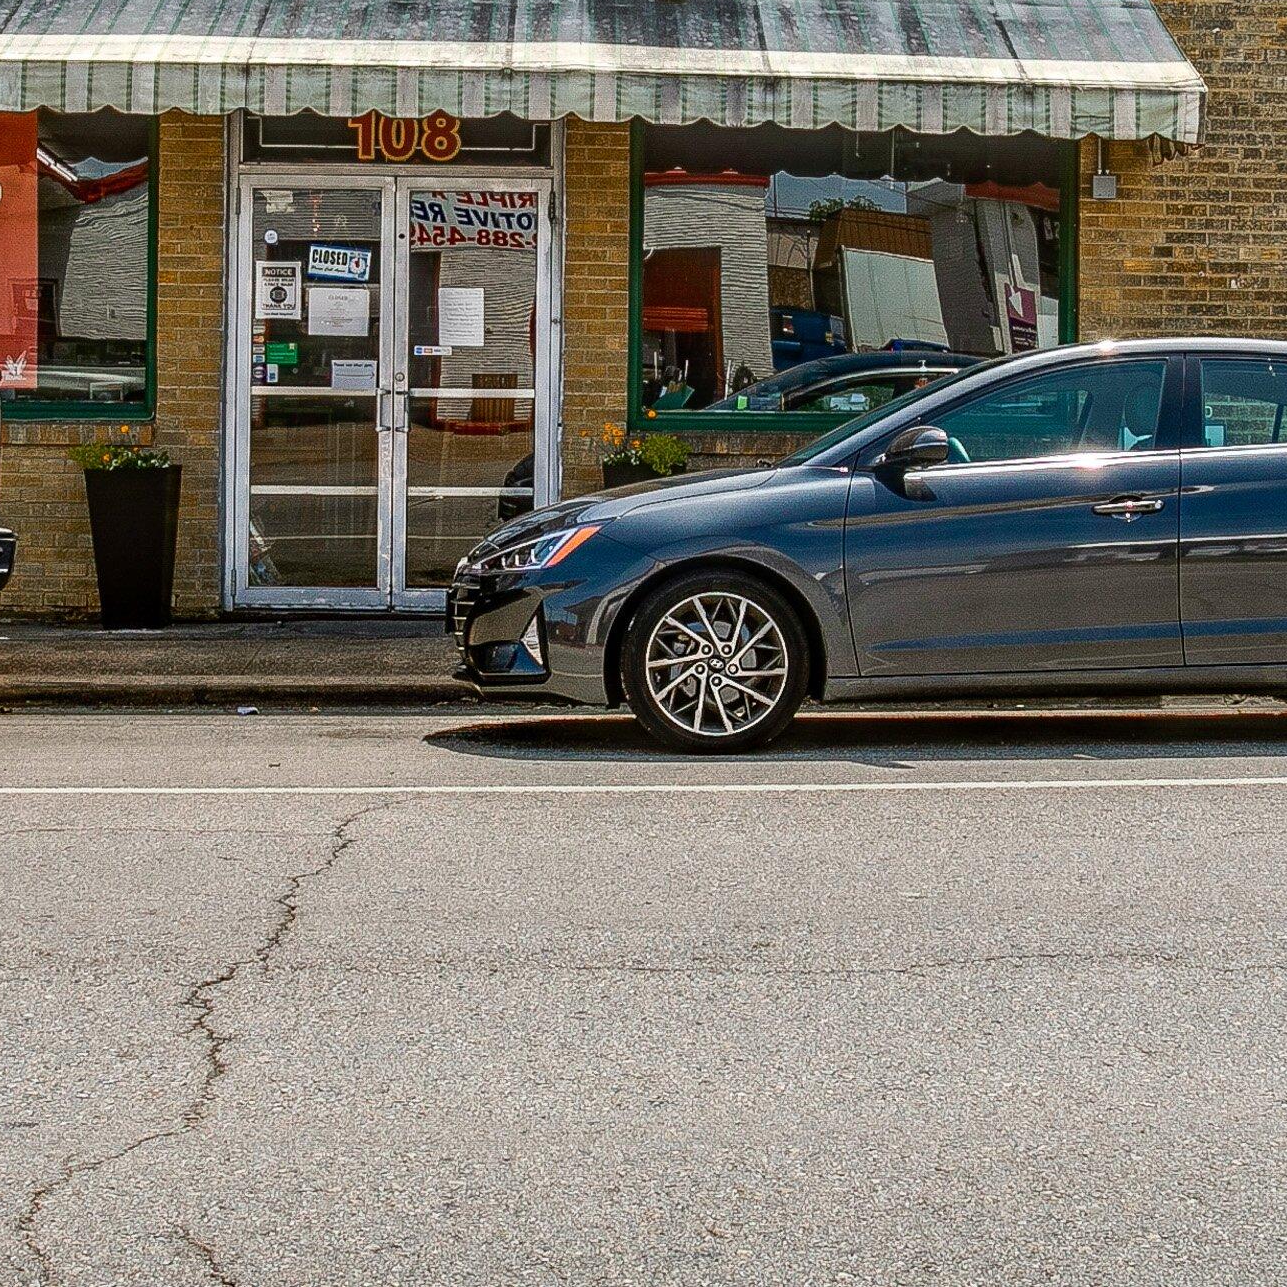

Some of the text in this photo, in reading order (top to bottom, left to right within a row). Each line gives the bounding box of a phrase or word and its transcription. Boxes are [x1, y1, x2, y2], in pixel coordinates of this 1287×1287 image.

[348, 110, 462, 161] 108
[313, 249, 348, 266] CLOSED
[264, 268, 293, 276] NOTICE
